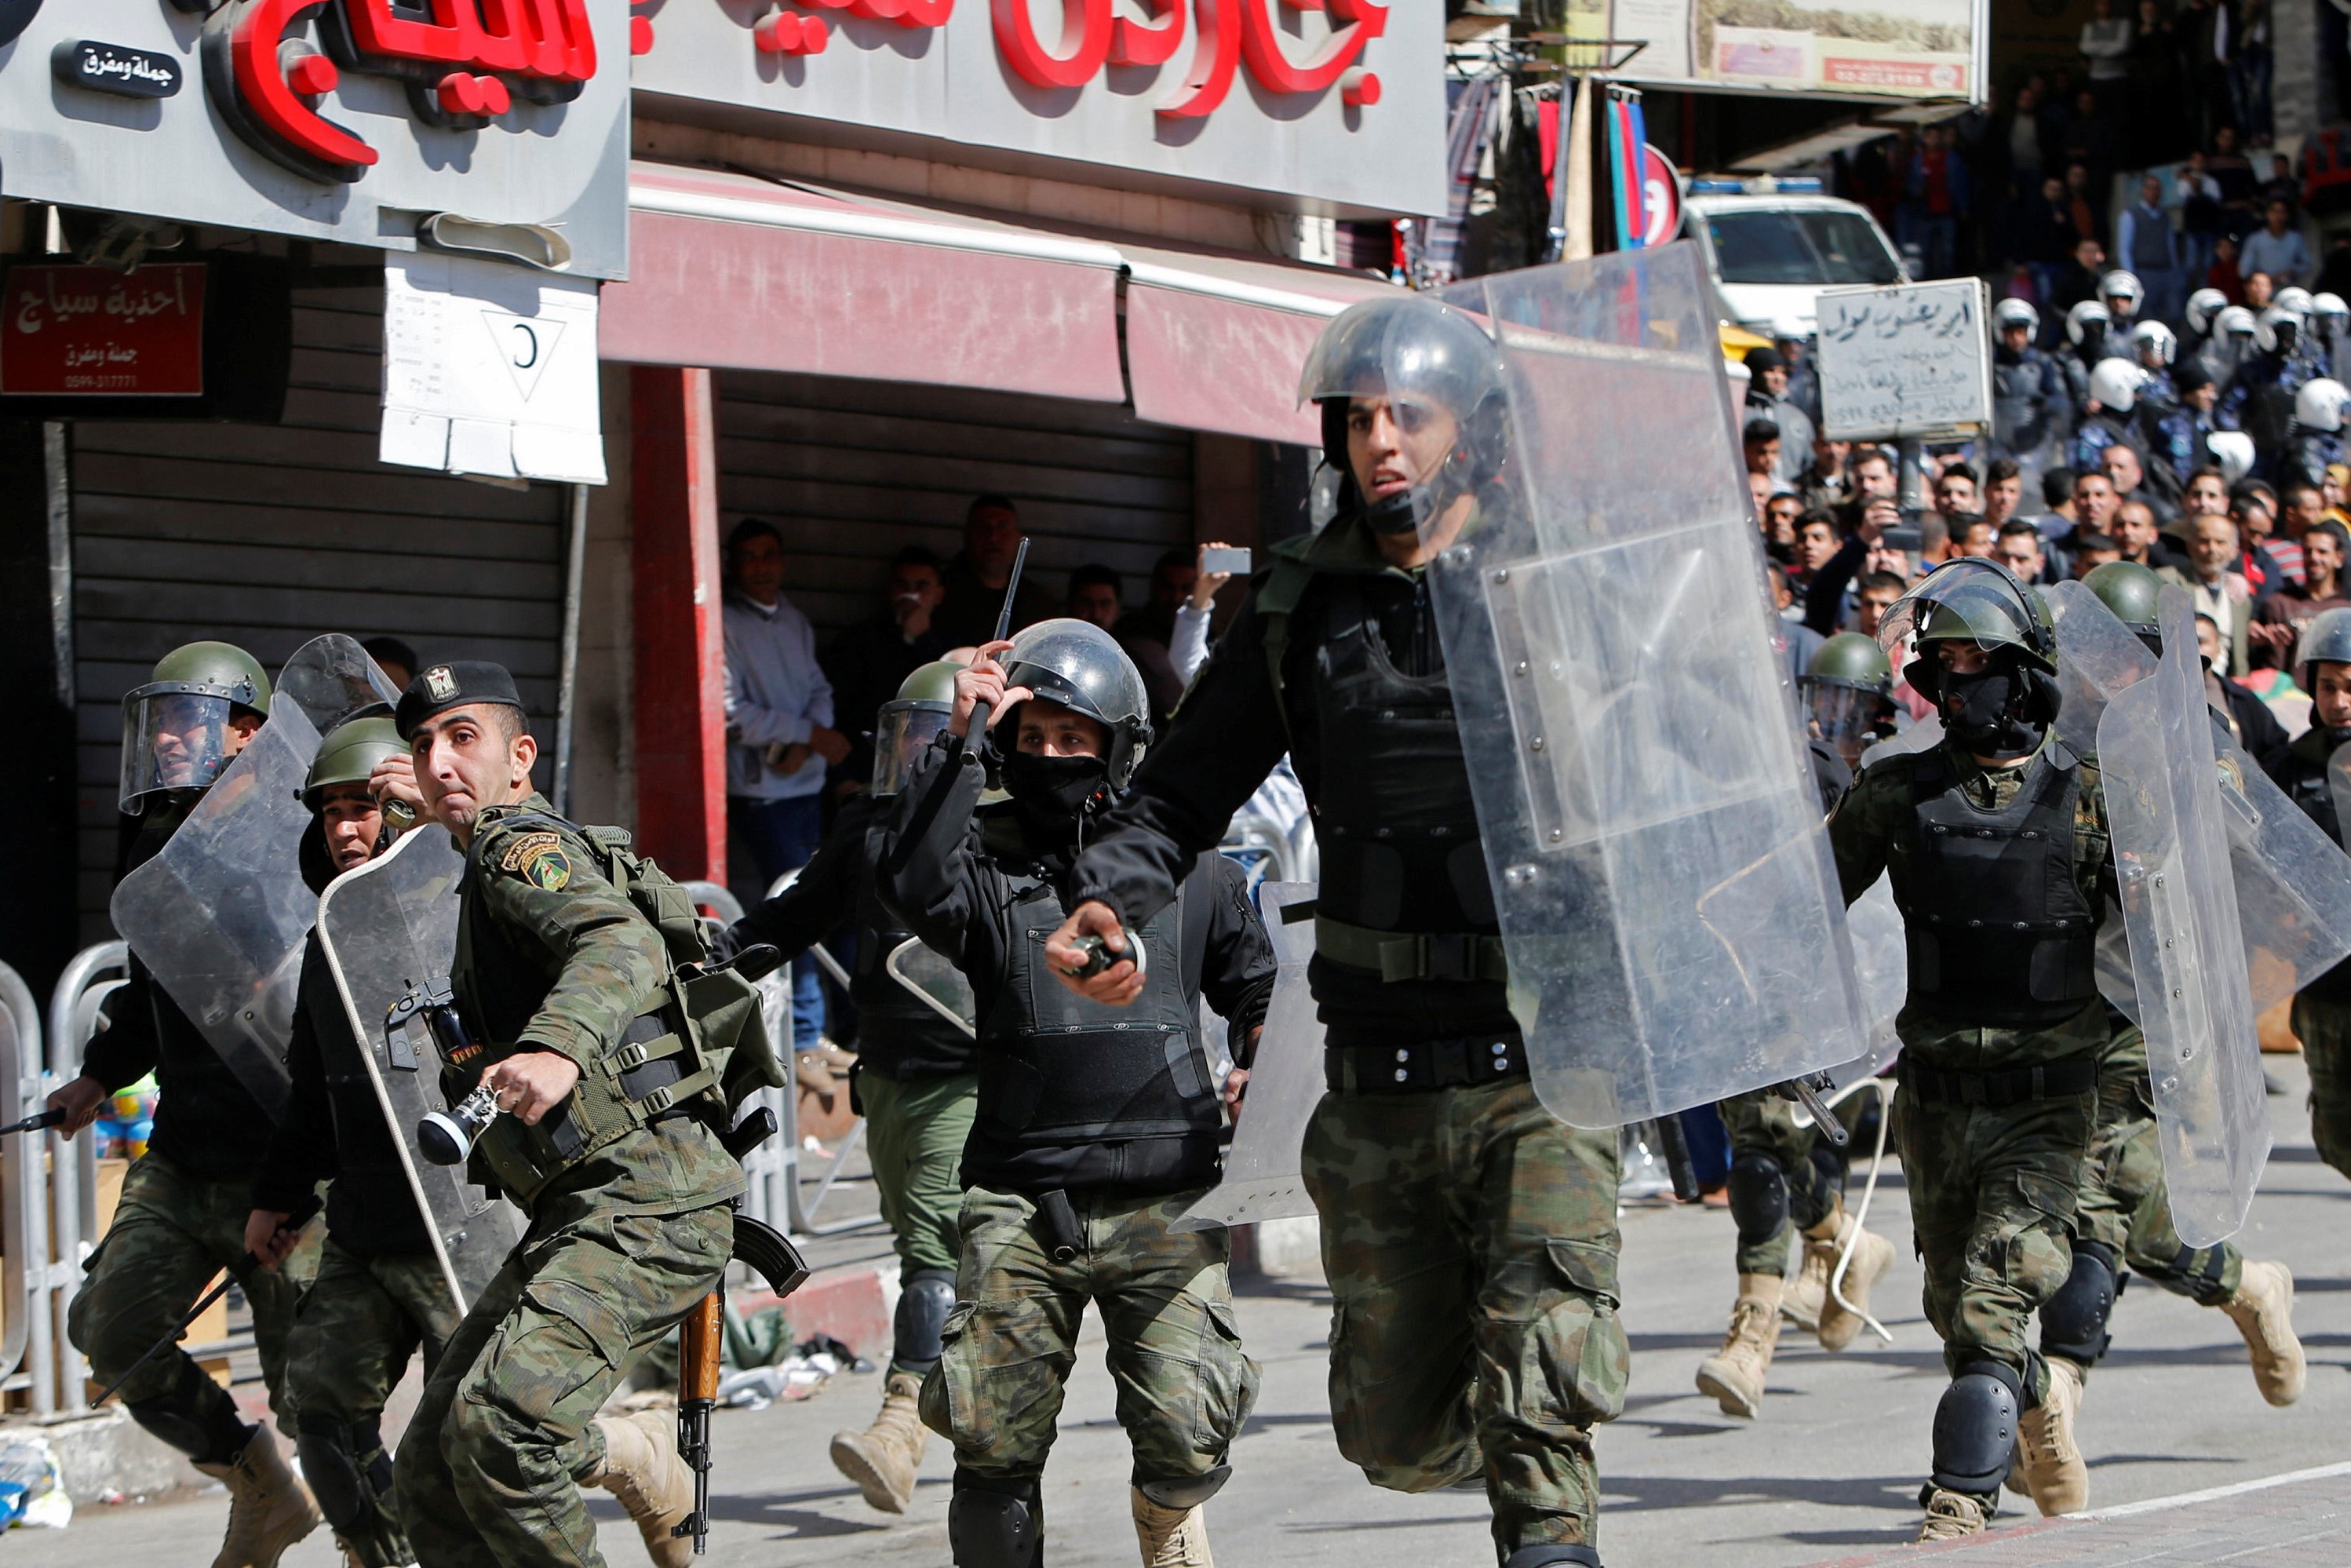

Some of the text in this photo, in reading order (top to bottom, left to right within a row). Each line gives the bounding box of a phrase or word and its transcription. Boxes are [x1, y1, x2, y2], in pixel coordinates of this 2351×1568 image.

[82, 48, 173, 87] جملة ومفرق
[17, 272, 99, 334] سياج
